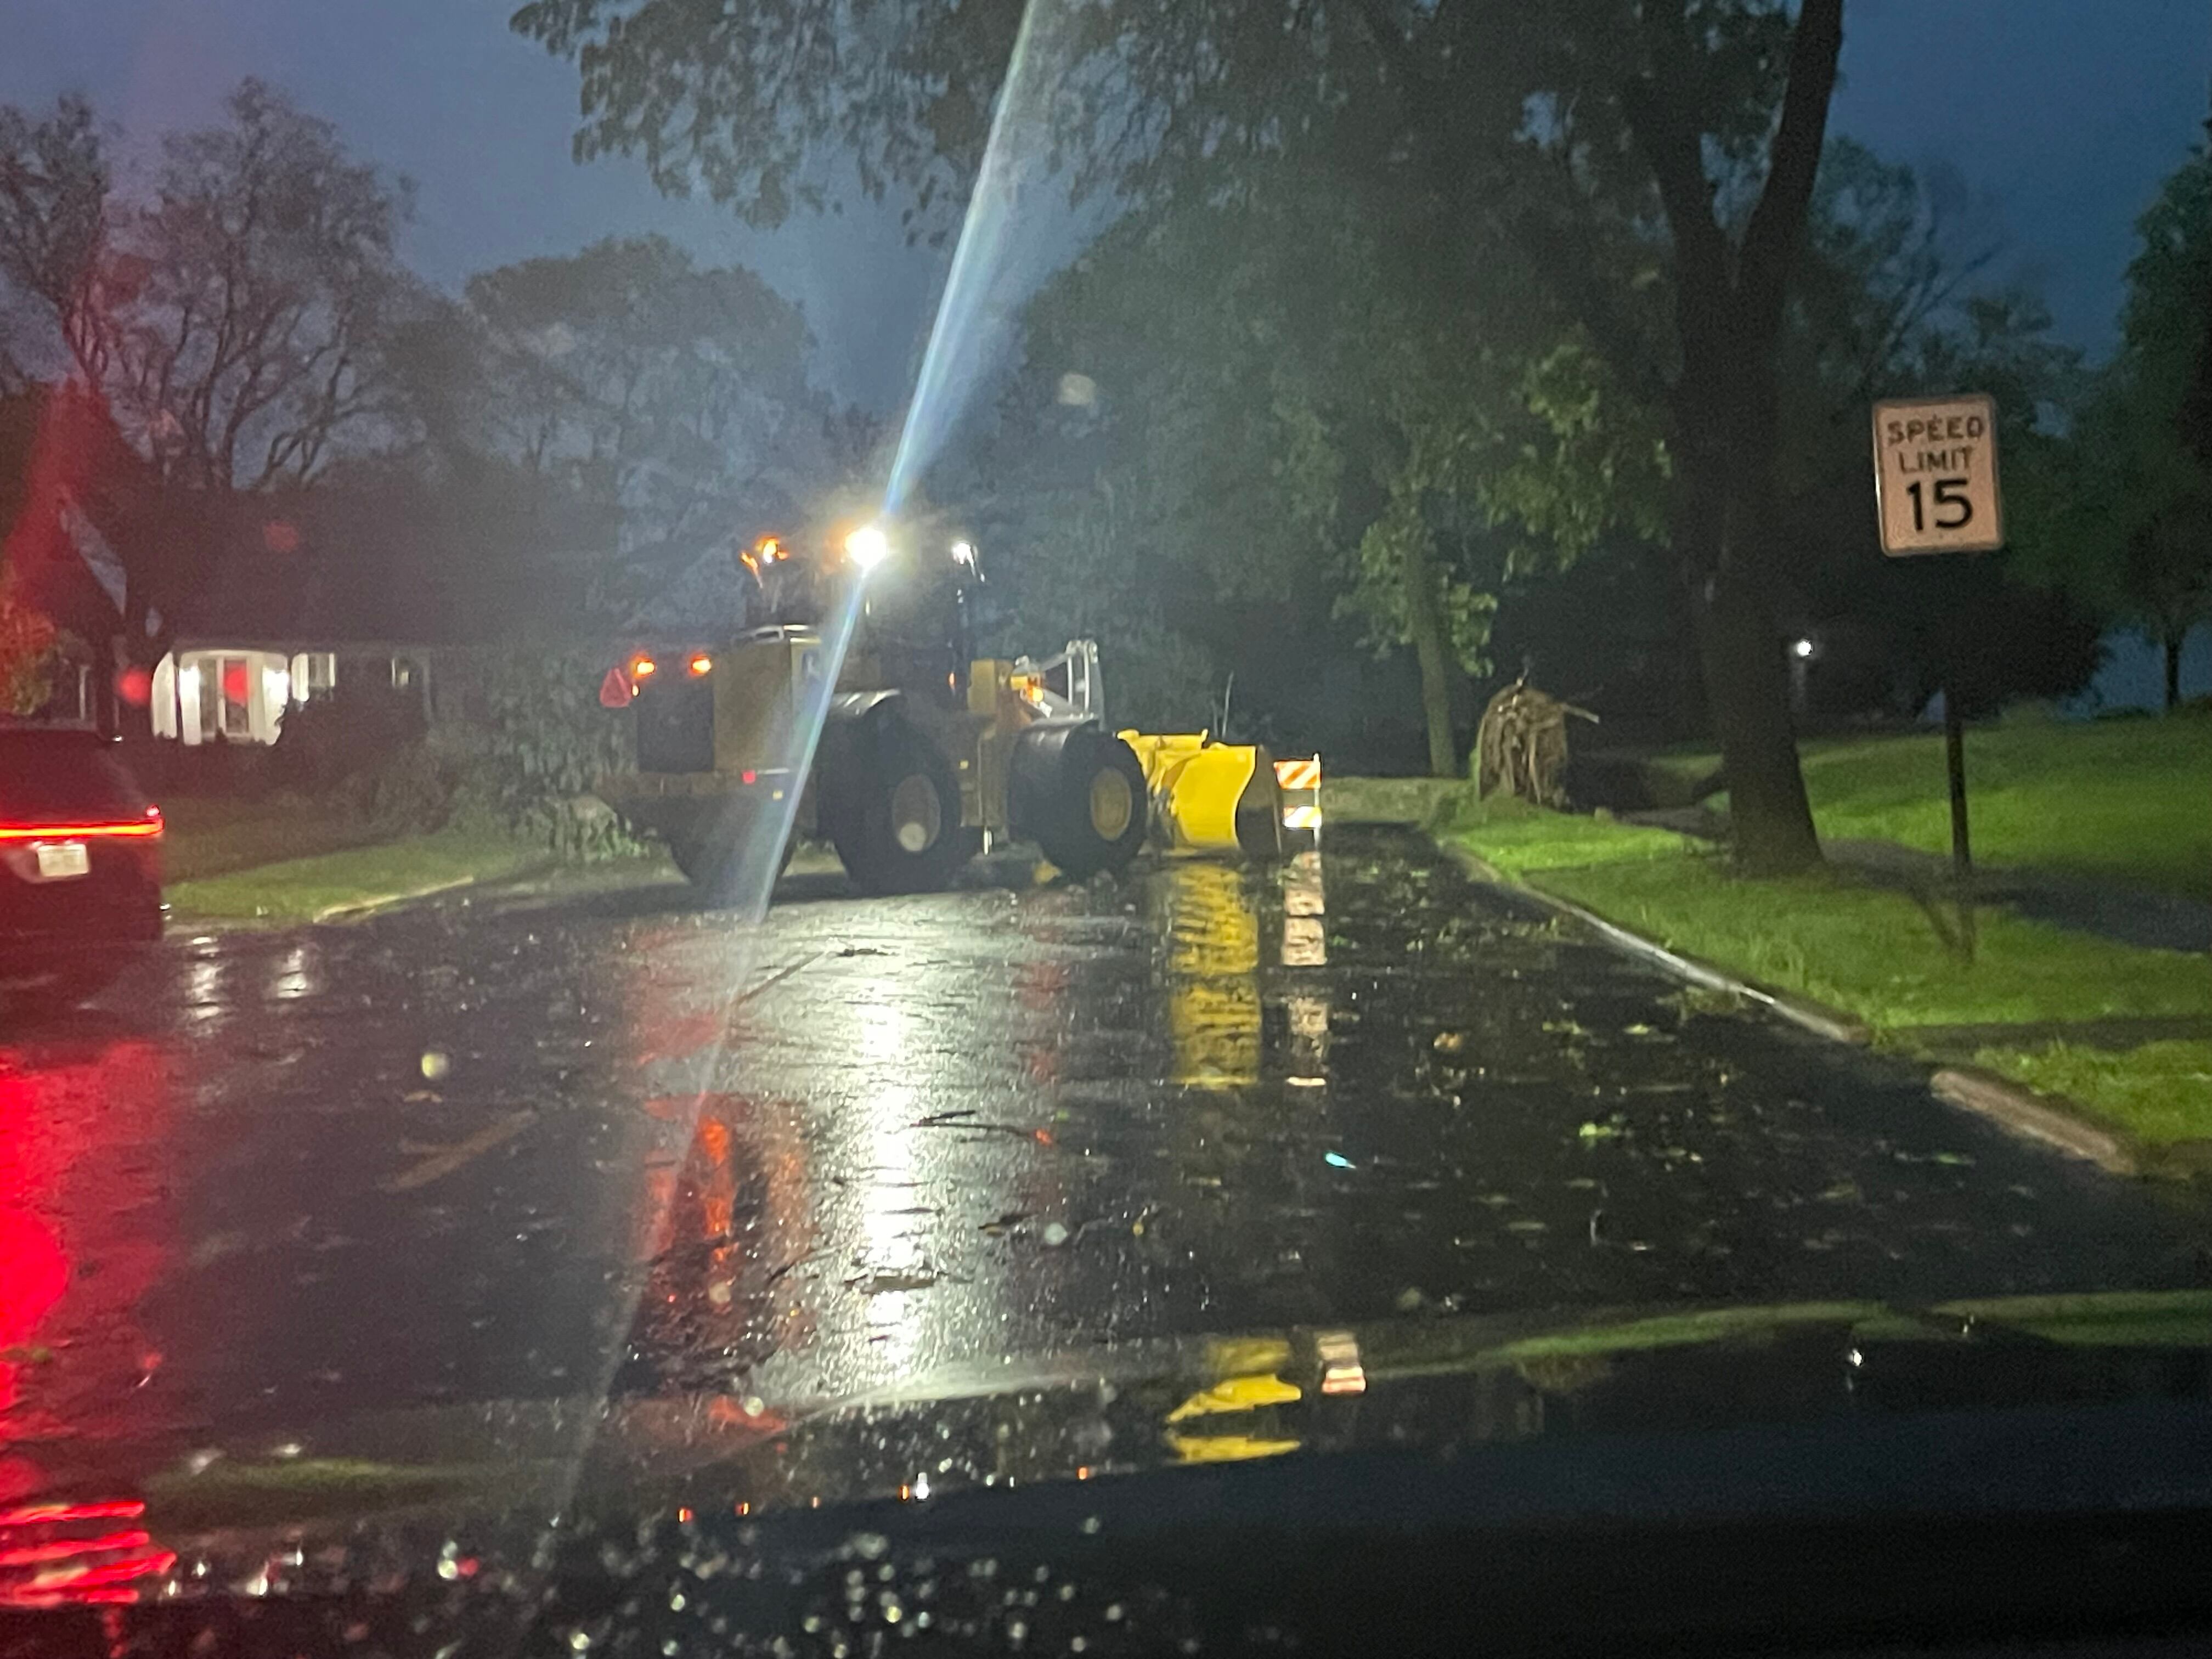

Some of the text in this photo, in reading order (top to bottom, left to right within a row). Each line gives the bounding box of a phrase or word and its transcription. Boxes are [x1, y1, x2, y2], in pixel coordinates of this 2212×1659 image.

[1887, 415, 1984, 445] SPEED
[1899, 445, 1973, 474] LIMIT
[1906, 478, 1973, 531] 15
